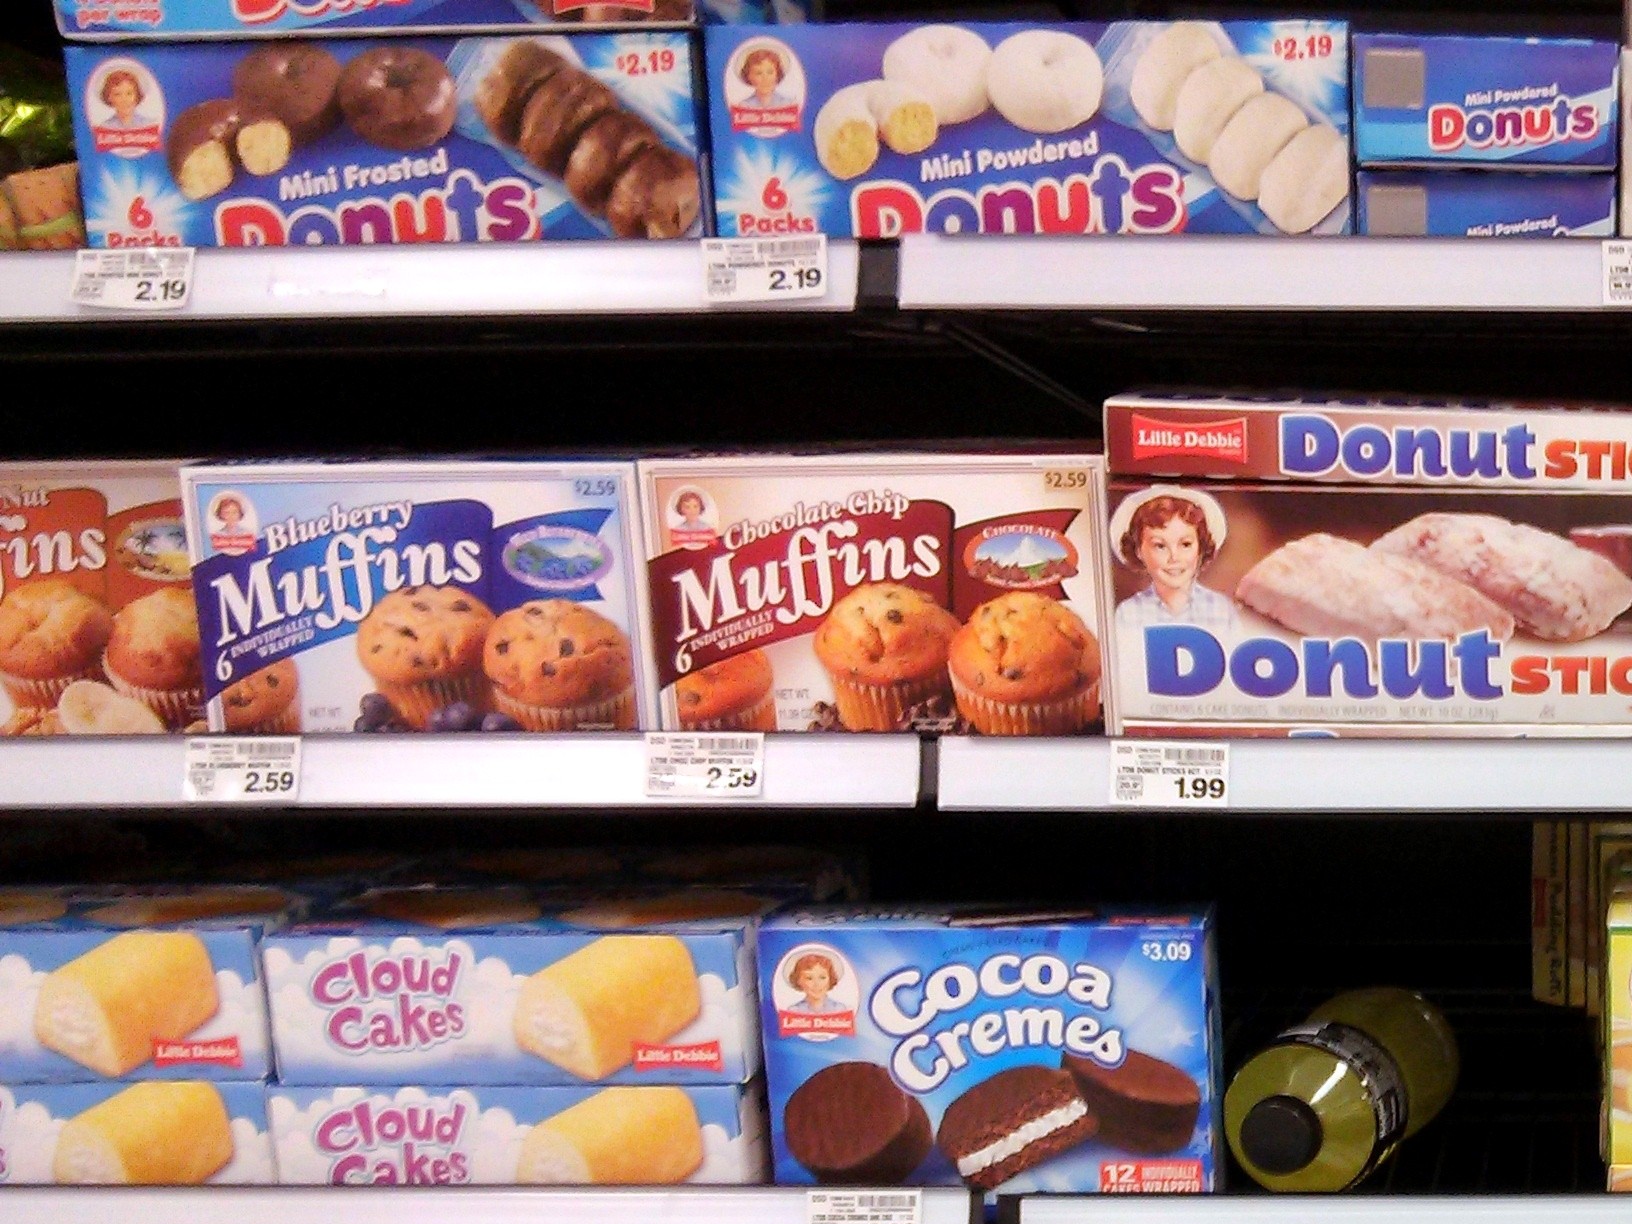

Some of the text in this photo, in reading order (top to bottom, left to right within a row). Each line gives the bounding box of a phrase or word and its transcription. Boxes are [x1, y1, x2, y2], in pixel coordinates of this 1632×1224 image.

[616, 50, 675, 77] $2.19
[1274, 35, 1333, 62] $2.19
[1465, 82, 1558, 107] Mini Powdered
[1428, 97, 1600, 151] Donuts
[920, 131, 1099, 183] Mini Powdered
[278, 148, 448, 202] Mini Frosted
[213, 170, 542, 245] Donuts
[762, 176, 788, 210] 6
[850, 153, 1190, 235] Donuts
[128, 197, 153, 230] 6
[739, 212, 814, 234] Packs
[134, 279, 187, 302] 2.19
[768, 267, 823, 291] 2.19
[1137, 428, 1243, 449] Little Debbie
[1279, 412, 1537, 481] Donut
[575, 479, 615, 497] $2.59
[1045, 471, 1087, 489] $2.59
[264, 500, 414, 552] Blueberry
[724, 487, 911, 550] Chocolate Chip
[211, 525, 484, 646] Muffins
[673, 520, 944, 644] Muffins
[717, 622, 775, 654] WRAPPED
[214, 653, 234, 682] 6
[676, 644, 693, 674] 6
[1143, 628, 1504, 700] Donut
[244, 770, 294, 792] 2.59
[705, 767, 757, 789] 2.59
[1172, 776, 1225, 801] 1.99
[1141, 942, 1191, 961] $3.09
[311, 953, 462, 1006] Cloud
[869, 953, 1114, 1037] Cocoa
[327, 993, 465, 1053] Cakes
[781, 1016, 852, 1031] Little Debbie
[891, 1007, 1128, 1094] Cremes
[317, 1103, 468, 1155] Cloud
[1104, 1164, 1137, 1185] 12
